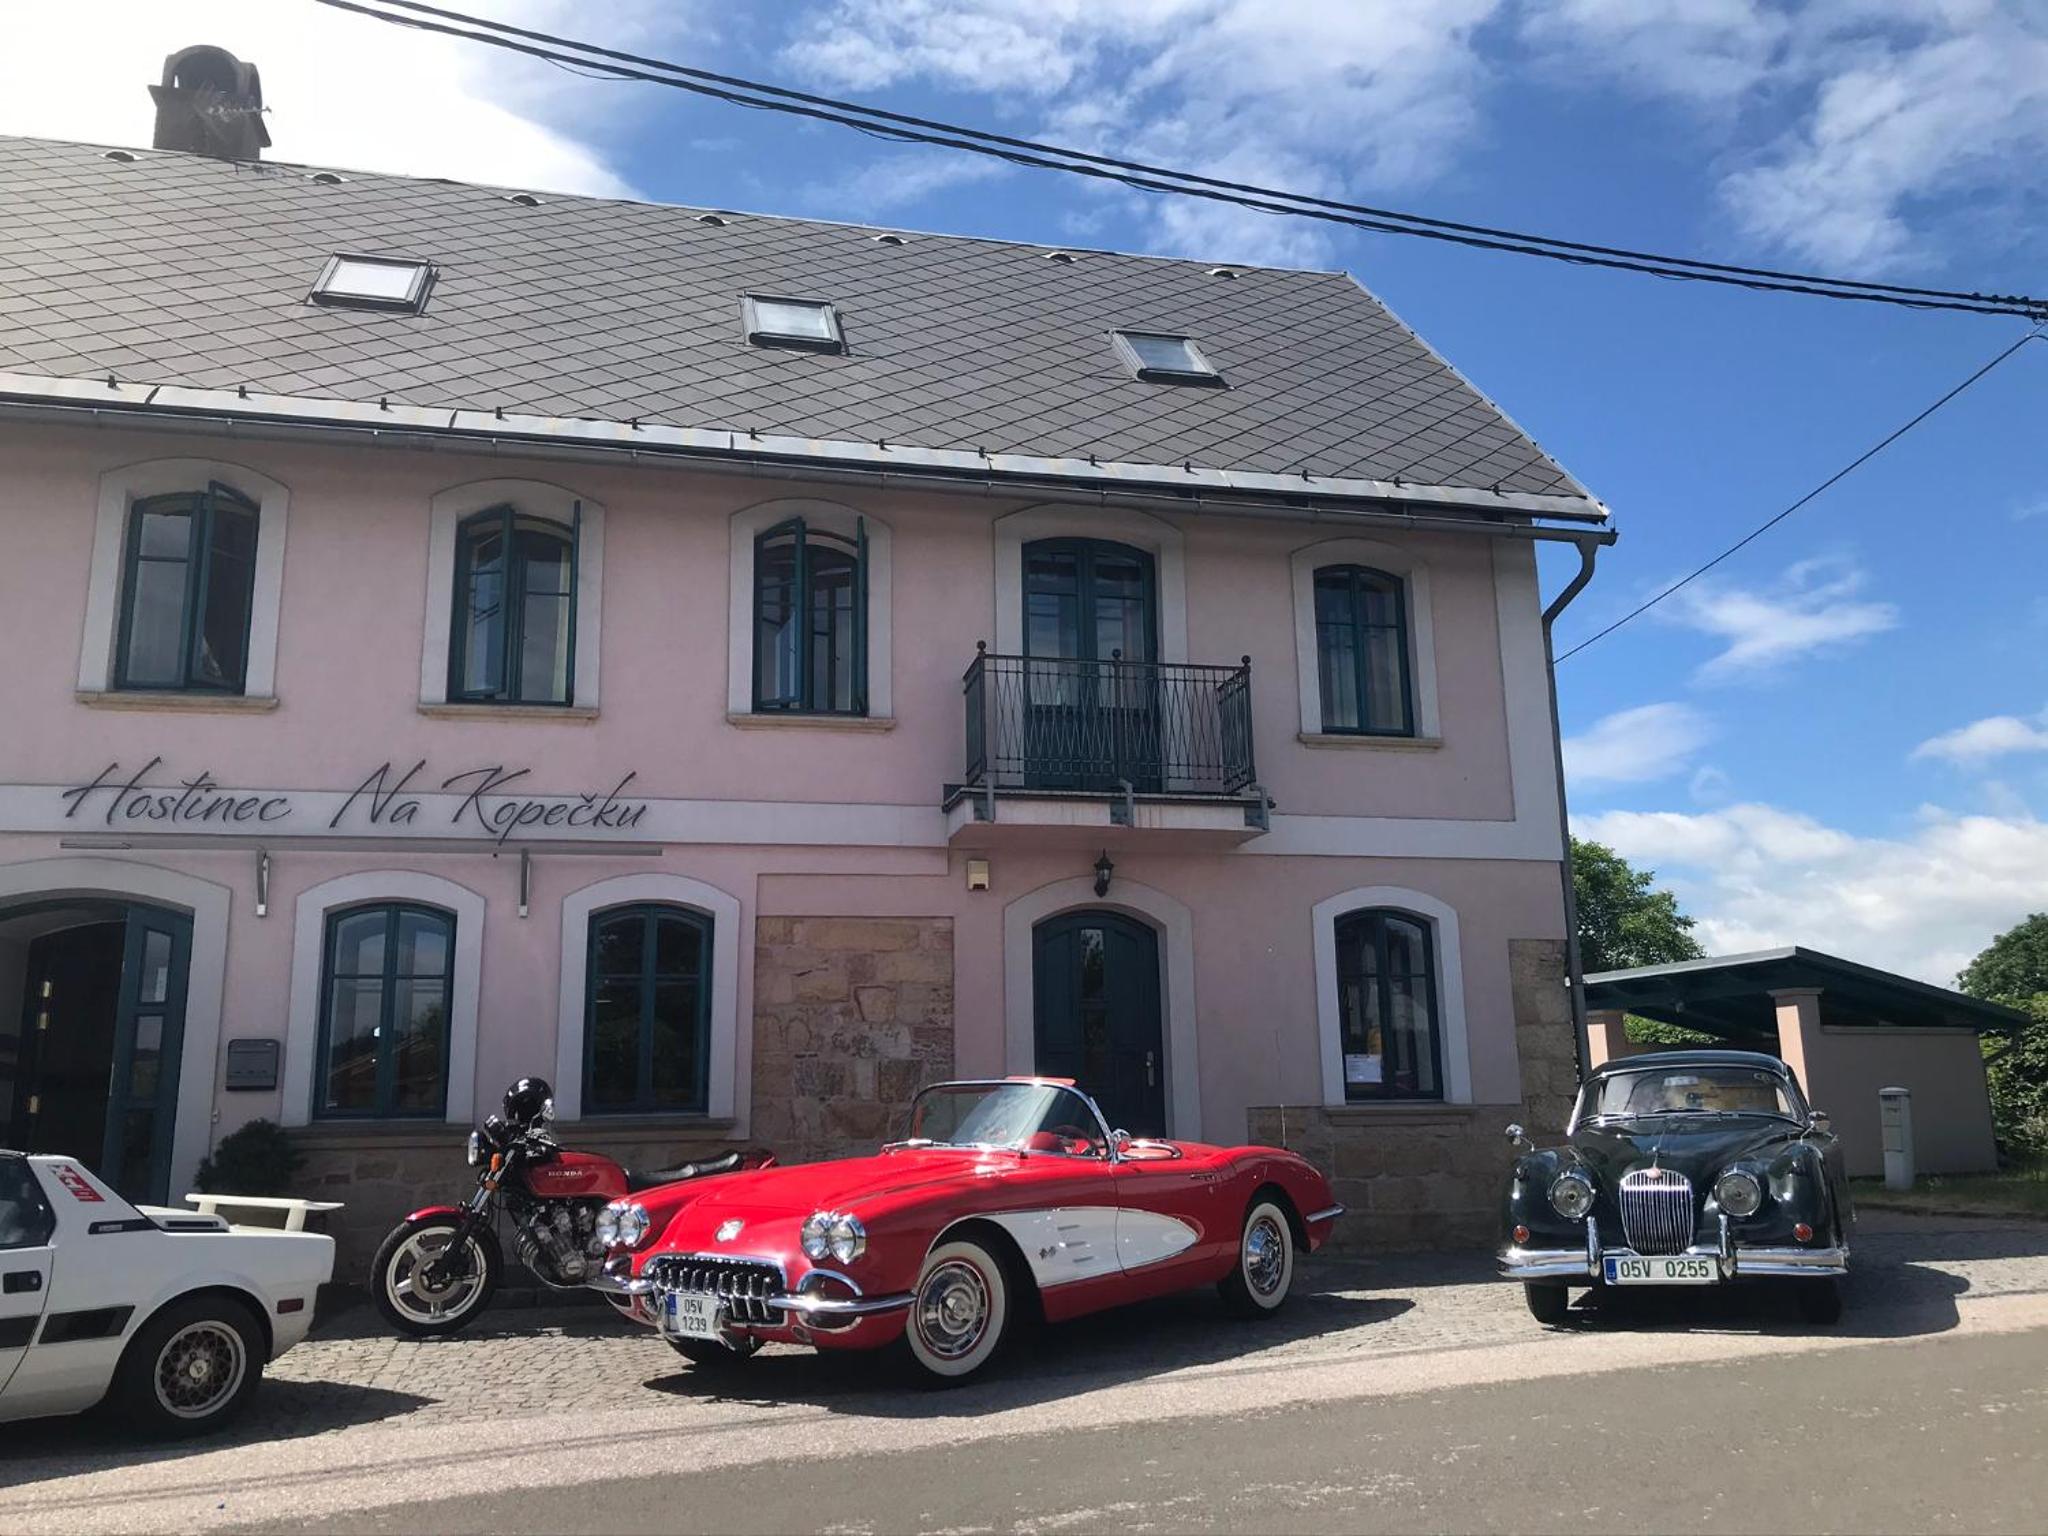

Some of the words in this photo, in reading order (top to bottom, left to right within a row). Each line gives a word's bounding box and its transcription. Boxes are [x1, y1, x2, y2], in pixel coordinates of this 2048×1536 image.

[62, 757, 291, 825] Hostinec
[329, 760, 426, 828] Na
[441, 766, 646, 845] Kopečku
[548, 1170, 583, 1178] HONDA
[1620, 1261, 1650, 1278] 05V
[1665, 1261, 1709, 1278] 0255
[684, 1299, 703, 1314] 05V
[683, 1315, 707, 1332] 1239
